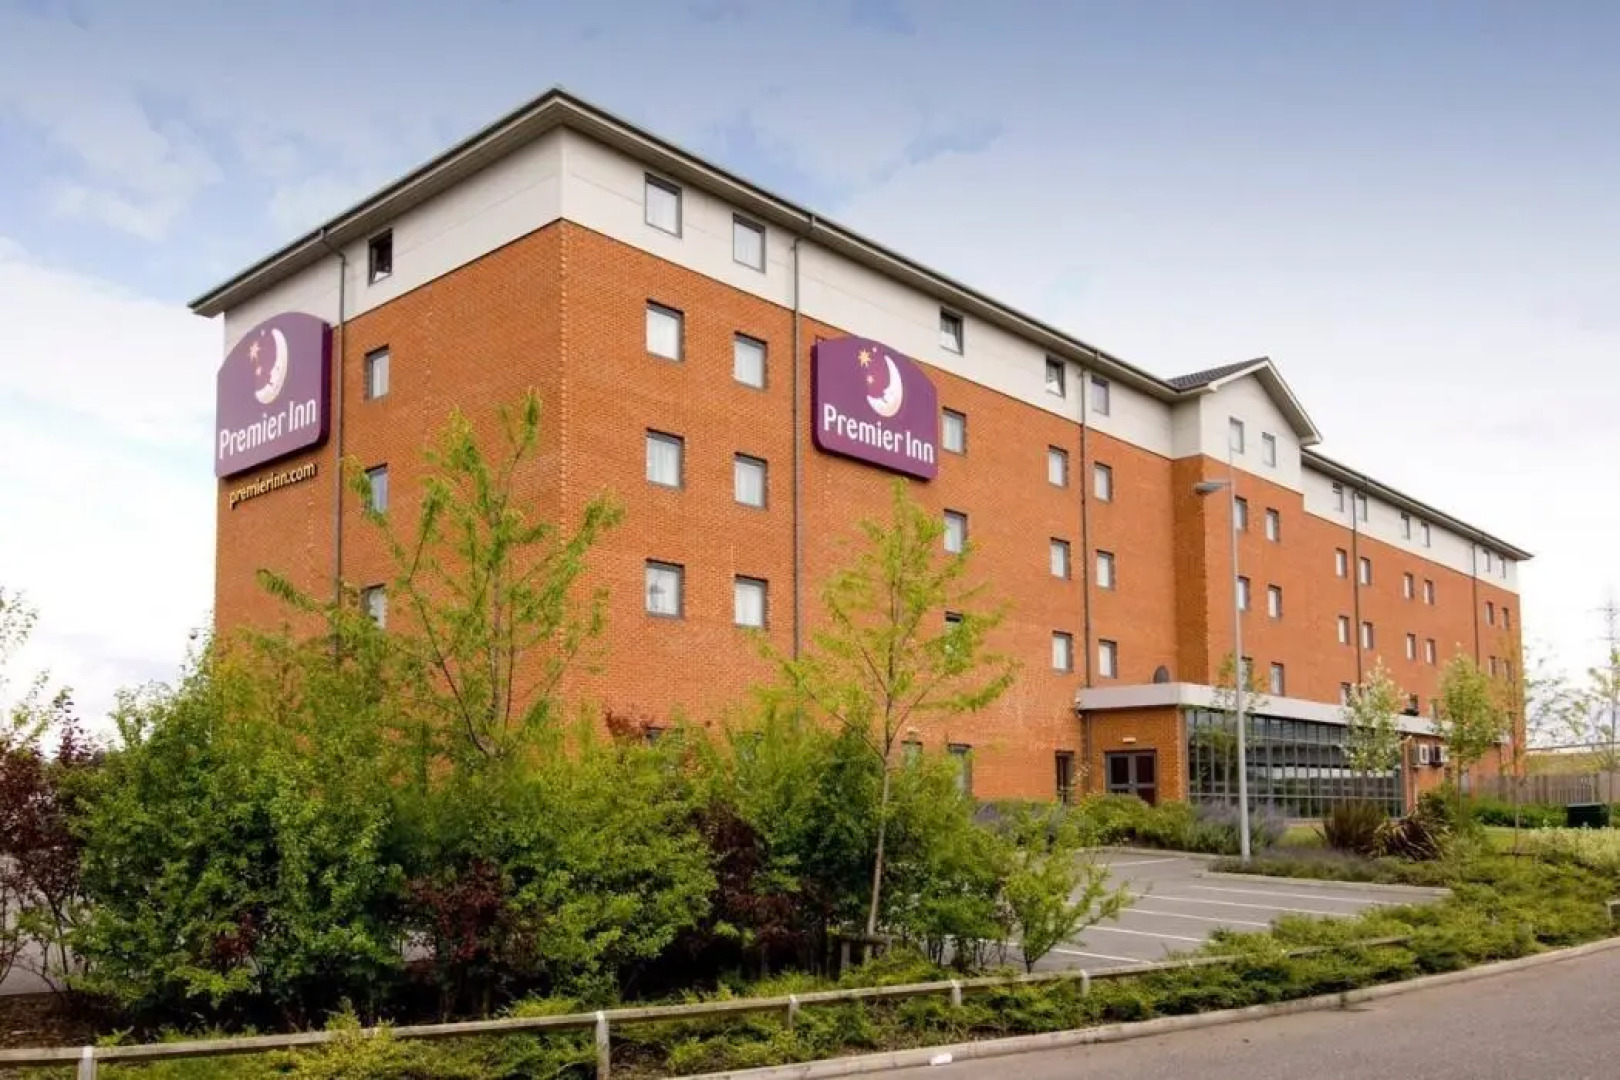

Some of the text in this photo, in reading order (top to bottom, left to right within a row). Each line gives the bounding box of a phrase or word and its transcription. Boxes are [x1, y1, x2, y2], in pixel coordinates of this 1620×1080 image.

[218, 398, 317, 460] Premier Inn
[822, 403, 934, 464] Premier Inn
[228, 462, 317, 511] premierinn.com
